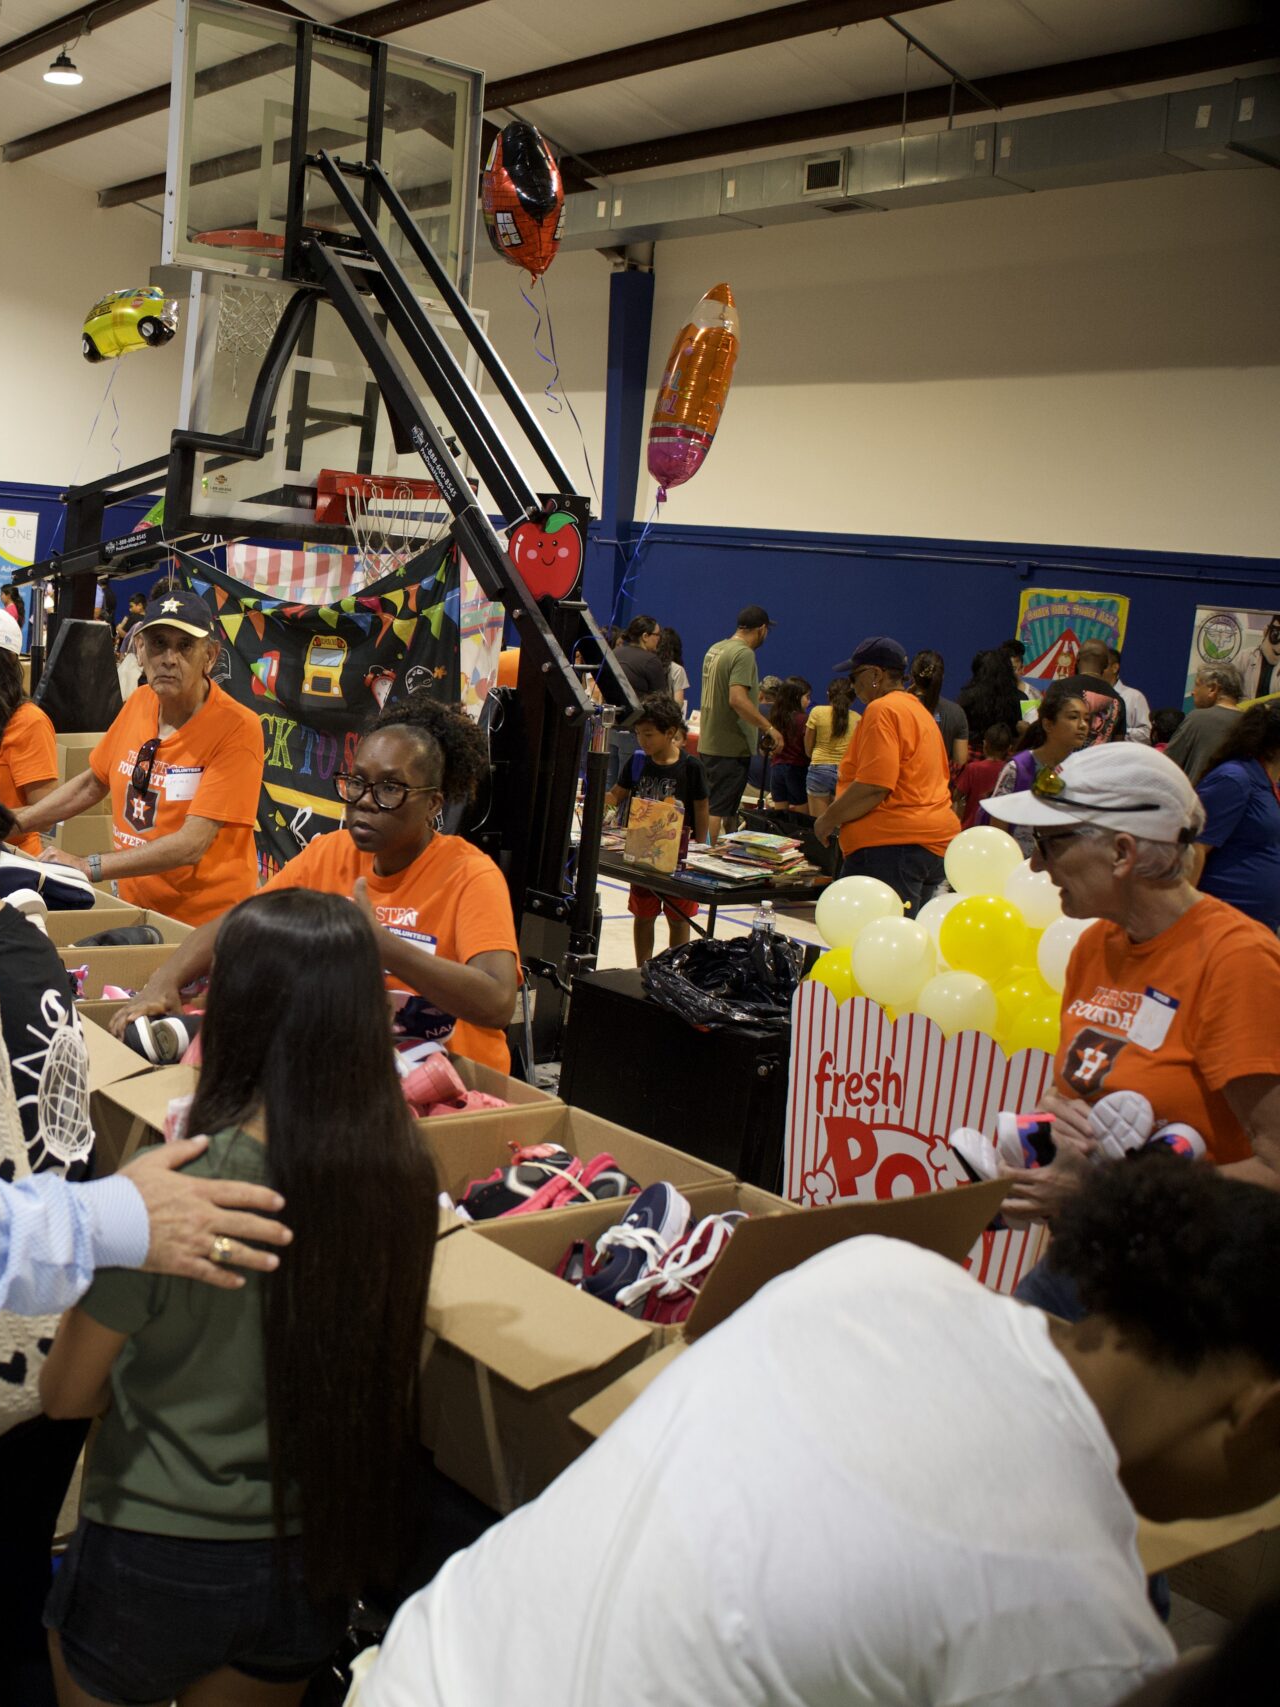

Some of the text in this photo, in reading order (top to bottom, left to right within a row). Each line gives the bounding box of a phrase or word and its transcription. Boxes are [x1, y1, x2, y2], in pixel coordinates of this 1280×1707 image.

[420, 447, 452, 502] ProDunkHoops.com
[424, 442, 457, 498] 1-888-600-8545
[260, 713, 298, 771] CK
[299, 723, 338, 781] TO
[132, 798, 147, 821] H
[388, 927, 433, 943] VOLUNTEER
[1067, 999, 1135, 1033] FOUNDA
[815, 1051, 902, 1115] fresh
[1073, 1047, 1108, 1081] H
[823, 1117, 932, 1200] PO
